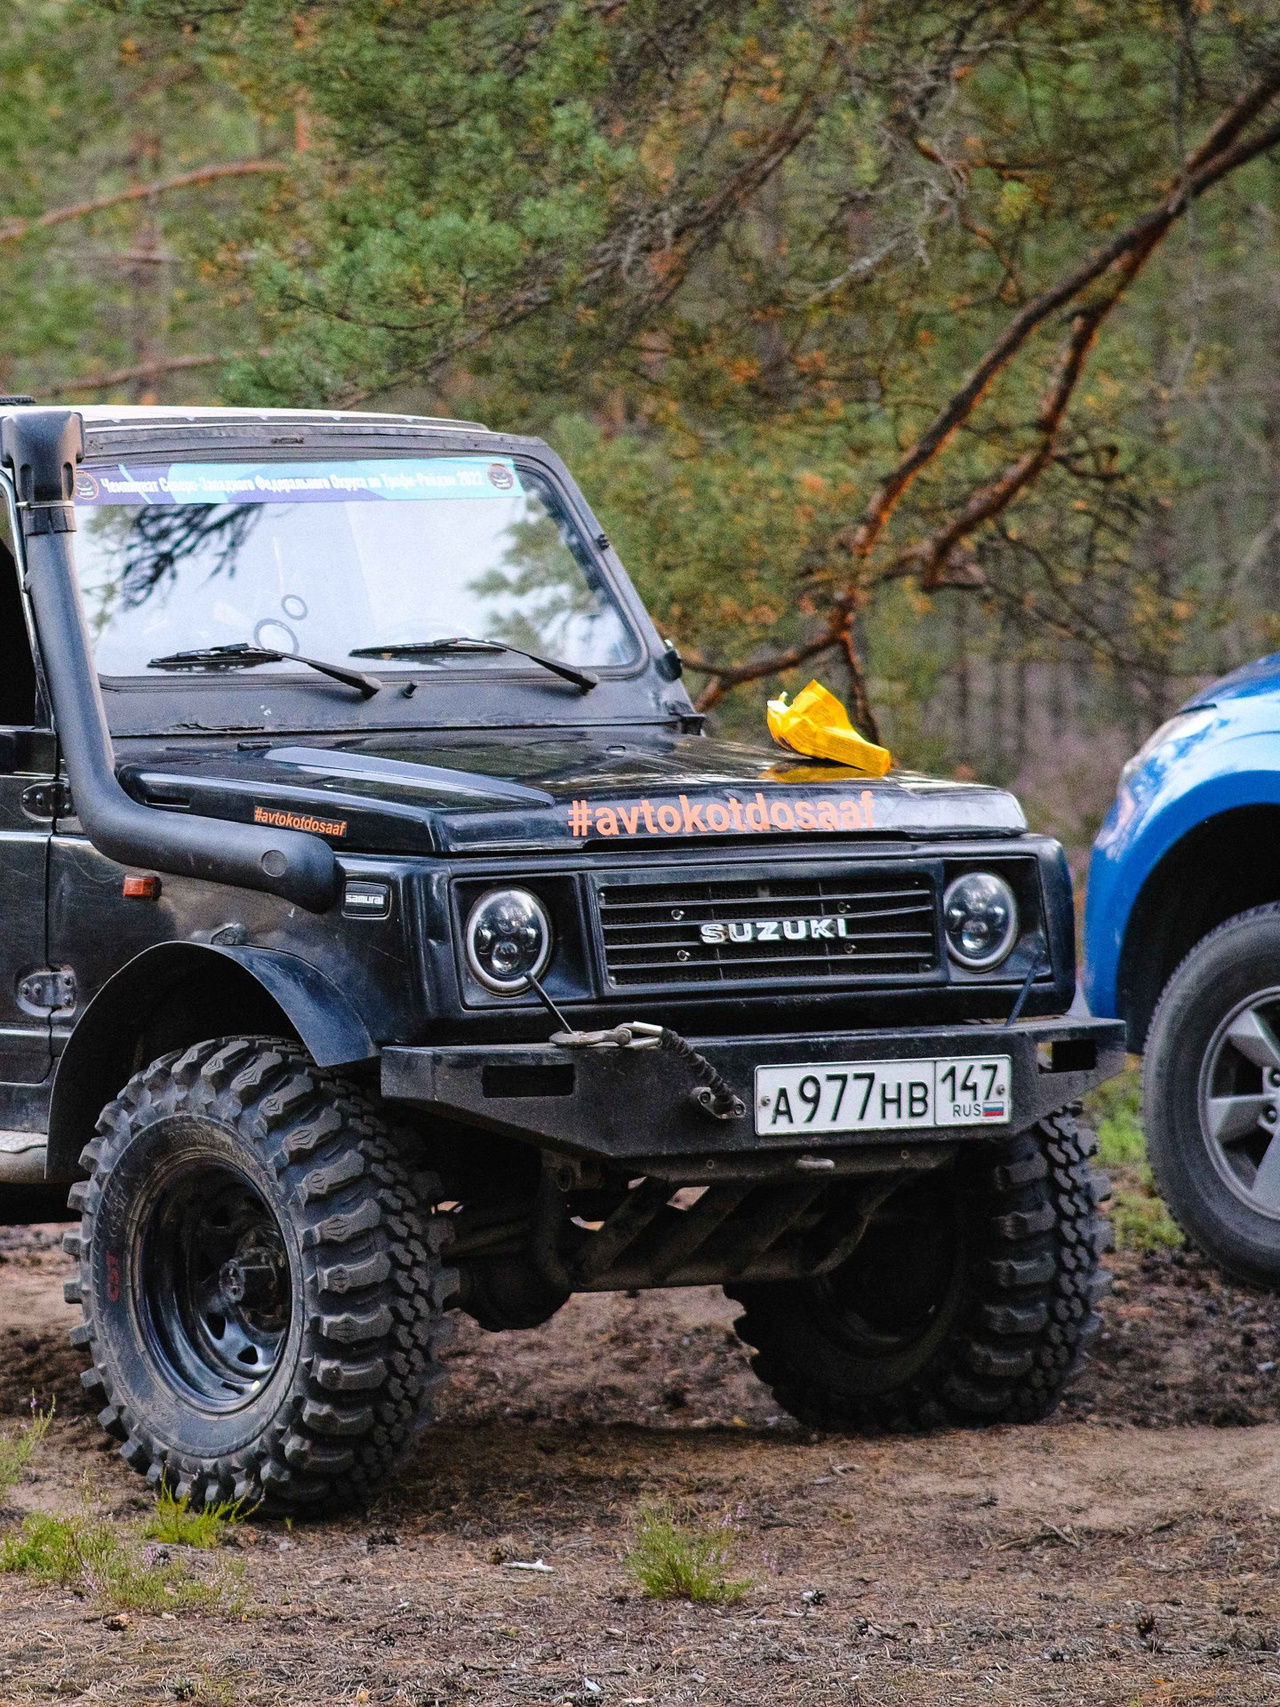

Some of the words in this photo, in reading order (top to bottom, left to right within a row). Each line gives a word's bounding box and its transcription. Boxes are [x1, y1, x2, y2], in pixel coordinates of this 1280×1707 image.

[254, 807, 348, 837] #avtokotdosaaf
[568, 790, 875, 837] #avtokotdosaaf
[345, 893, 384, 905] samurai
[700, 918, 847, 944] SUZUKI
[940, 1063, 999, 1103] 147
[952, 1103, 982, 1118] RUS
